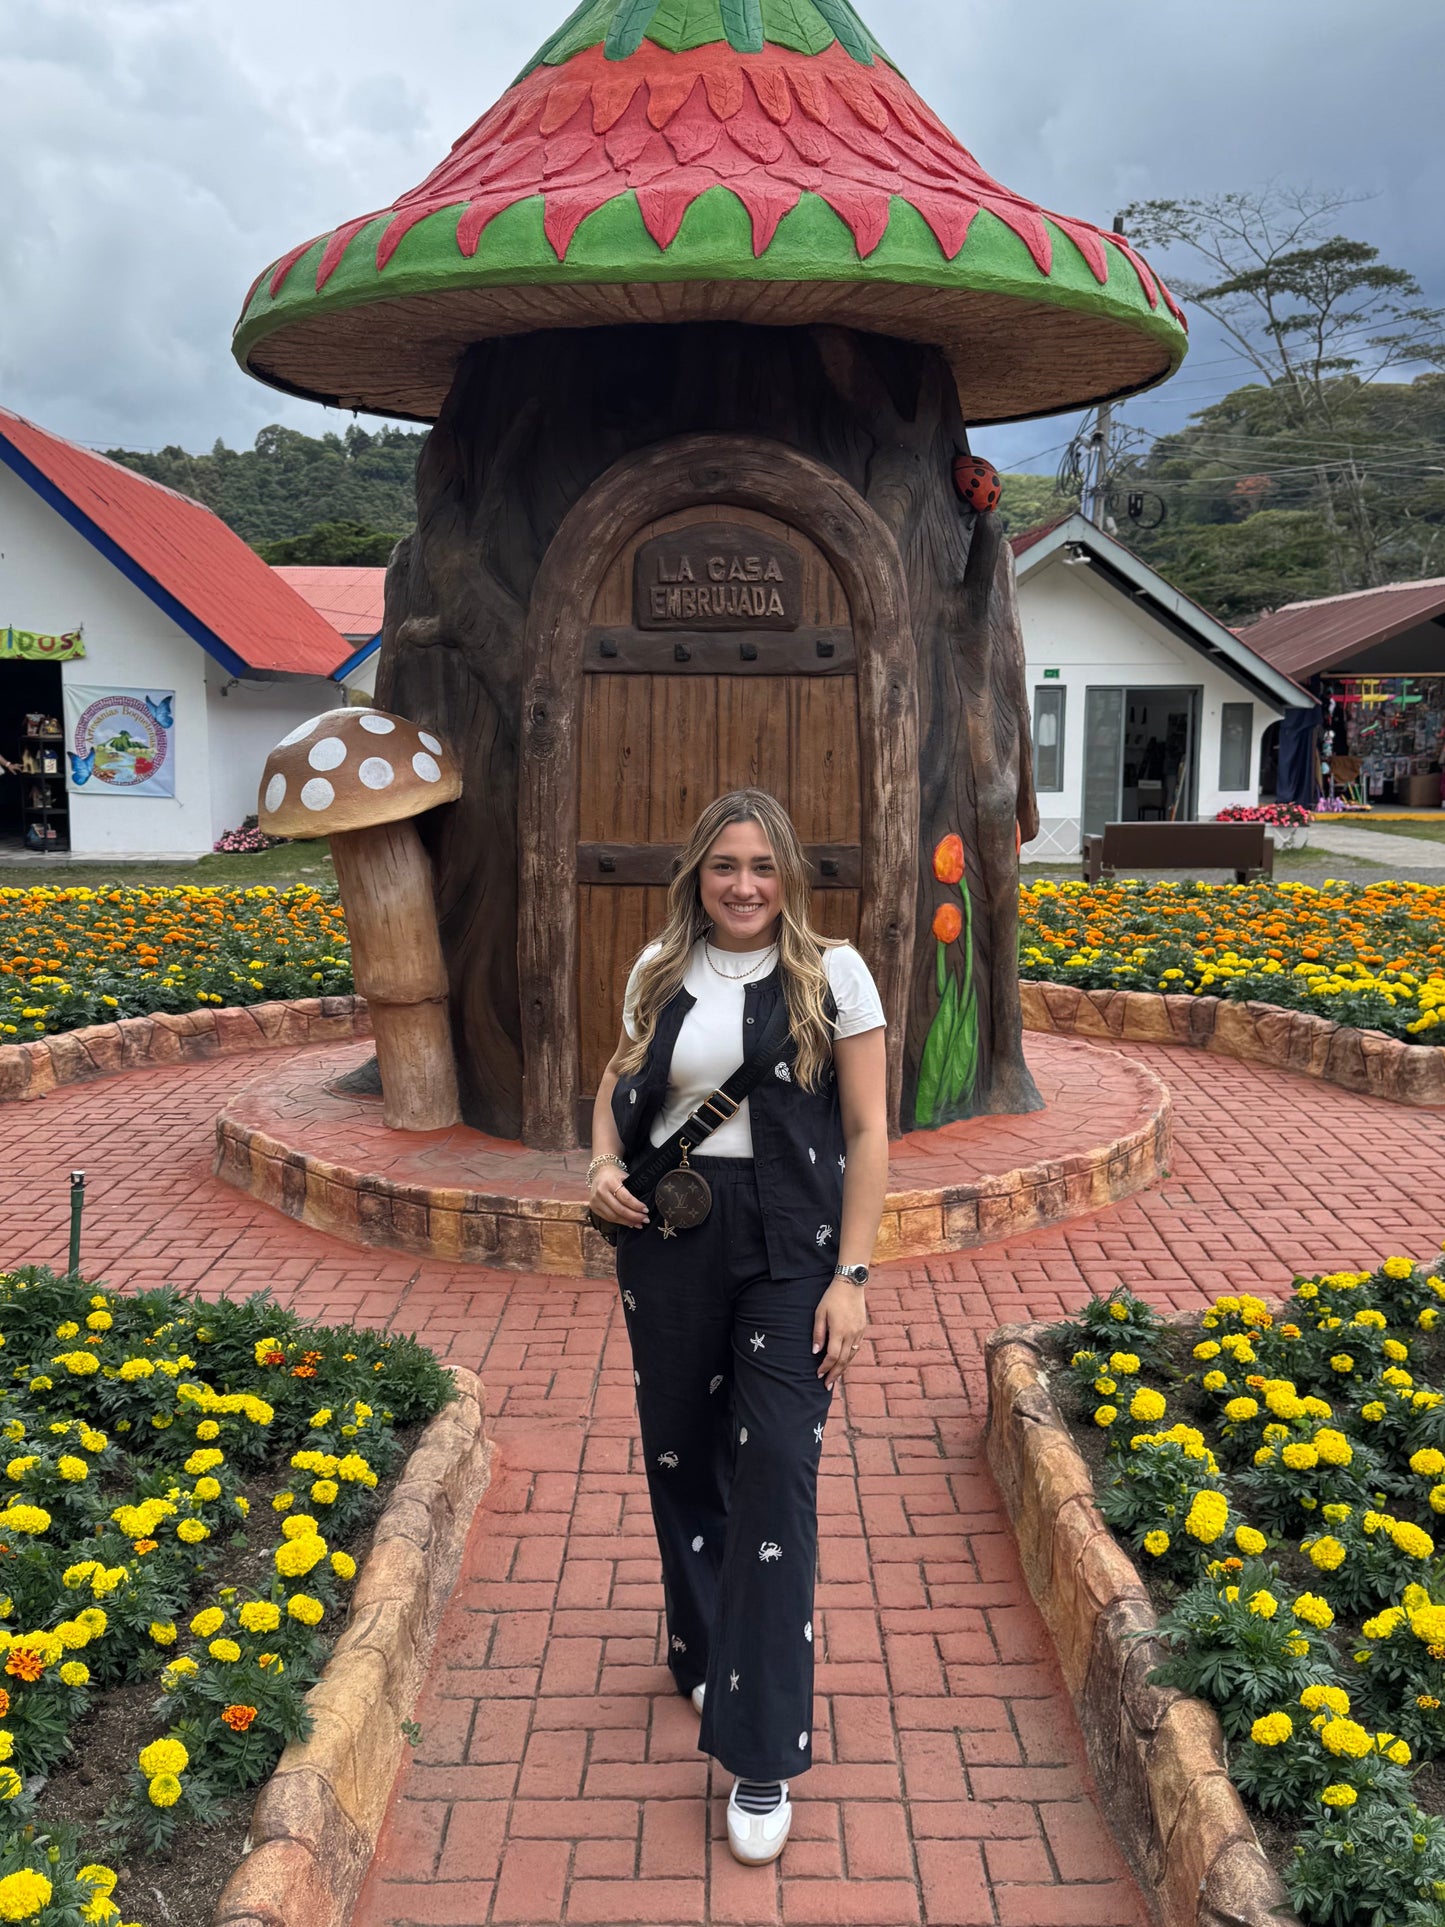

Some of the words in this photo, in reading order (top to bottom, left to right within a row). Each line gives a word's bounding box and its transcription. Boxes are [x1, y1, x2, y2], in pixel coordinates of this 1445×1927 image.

[658, 556, 695, 582] LA
[708, 556, 784, 582] CASA
[651, 586, 785, 619] EMBRUJADA
[0, 631, 73, 652] IDOS
